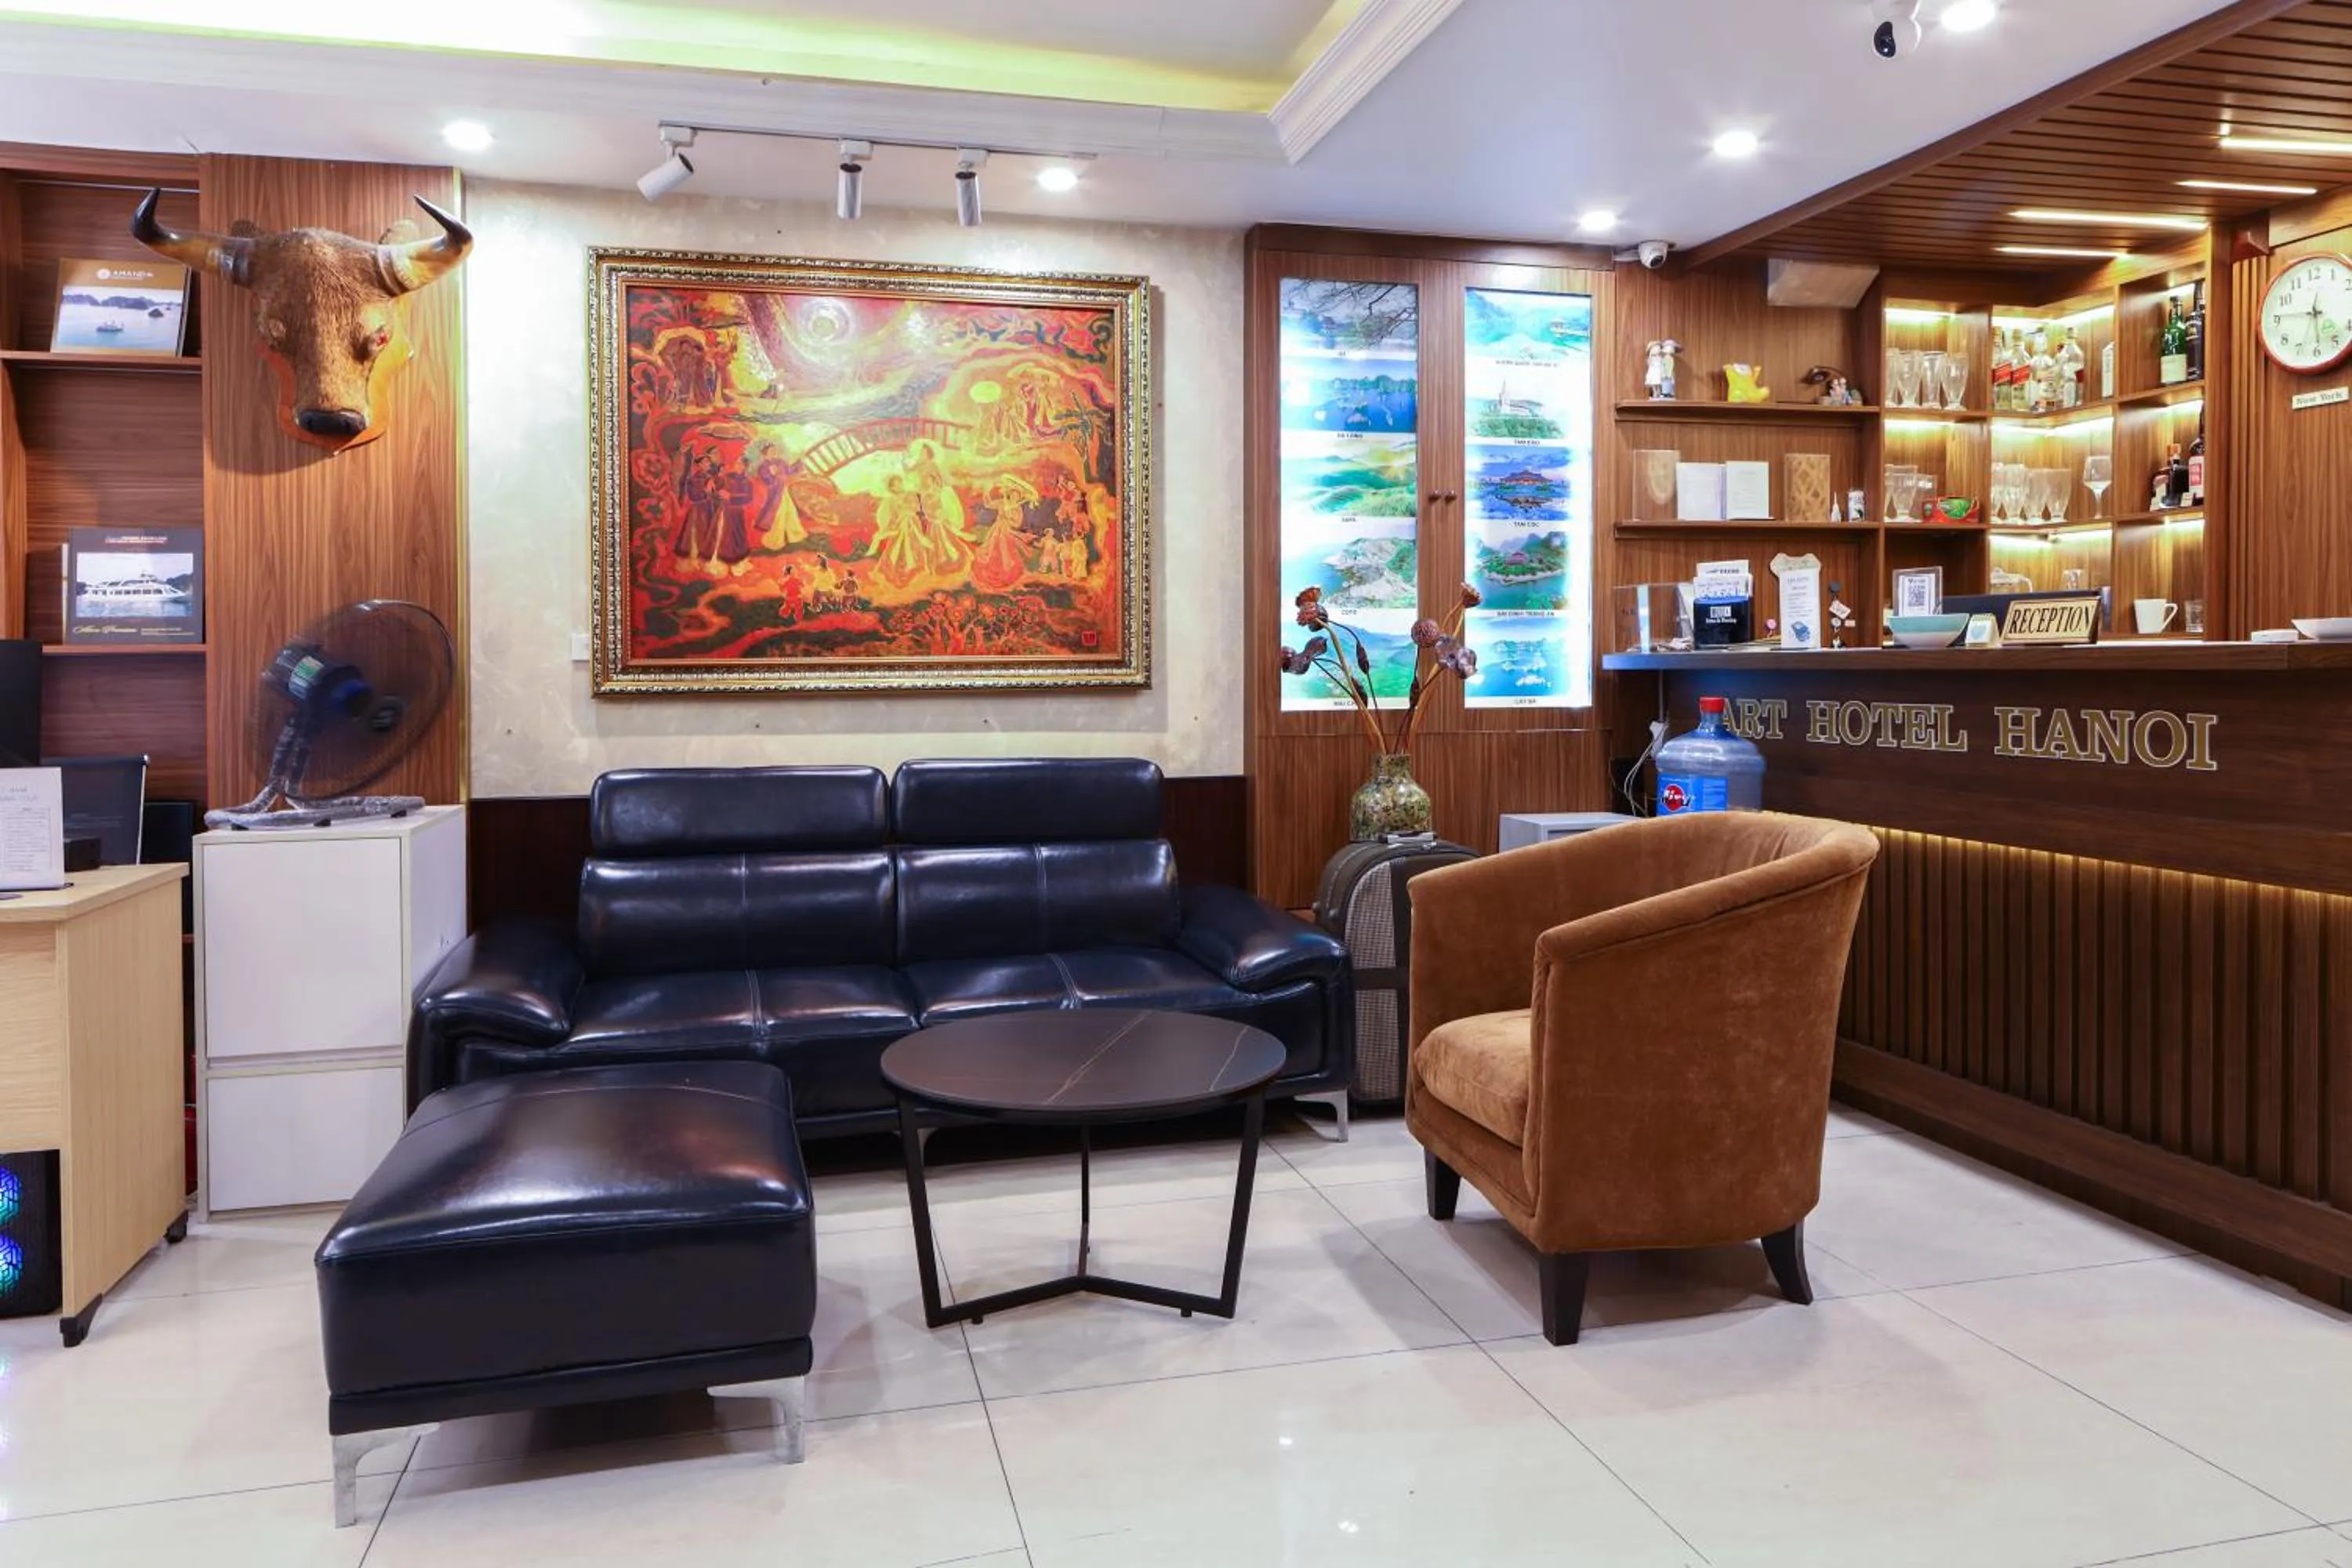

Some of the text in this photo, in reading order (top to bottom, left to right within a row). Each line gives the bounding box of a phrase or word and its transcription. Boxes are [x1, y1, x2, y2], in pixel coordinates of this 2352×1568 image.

[2307, 267, 2321, 281] 12
[2329, 268, 2336, 281] 1
[2290, 277, 2302, 291] 11
[2278, 293, 2292, 307] 10
[2274, 314, 2281, 328] 9
[2280, 333, 2288, 347] 8
[2331, 335, 2339, 349] 5
[2295, 342, 2303, 356] 7
[2313, 345, 2321, 358] 6
[2008, 605, 2095, 634] RECEPTION
[1722, 699, 2218, 771] ART HOTEL HANOI
